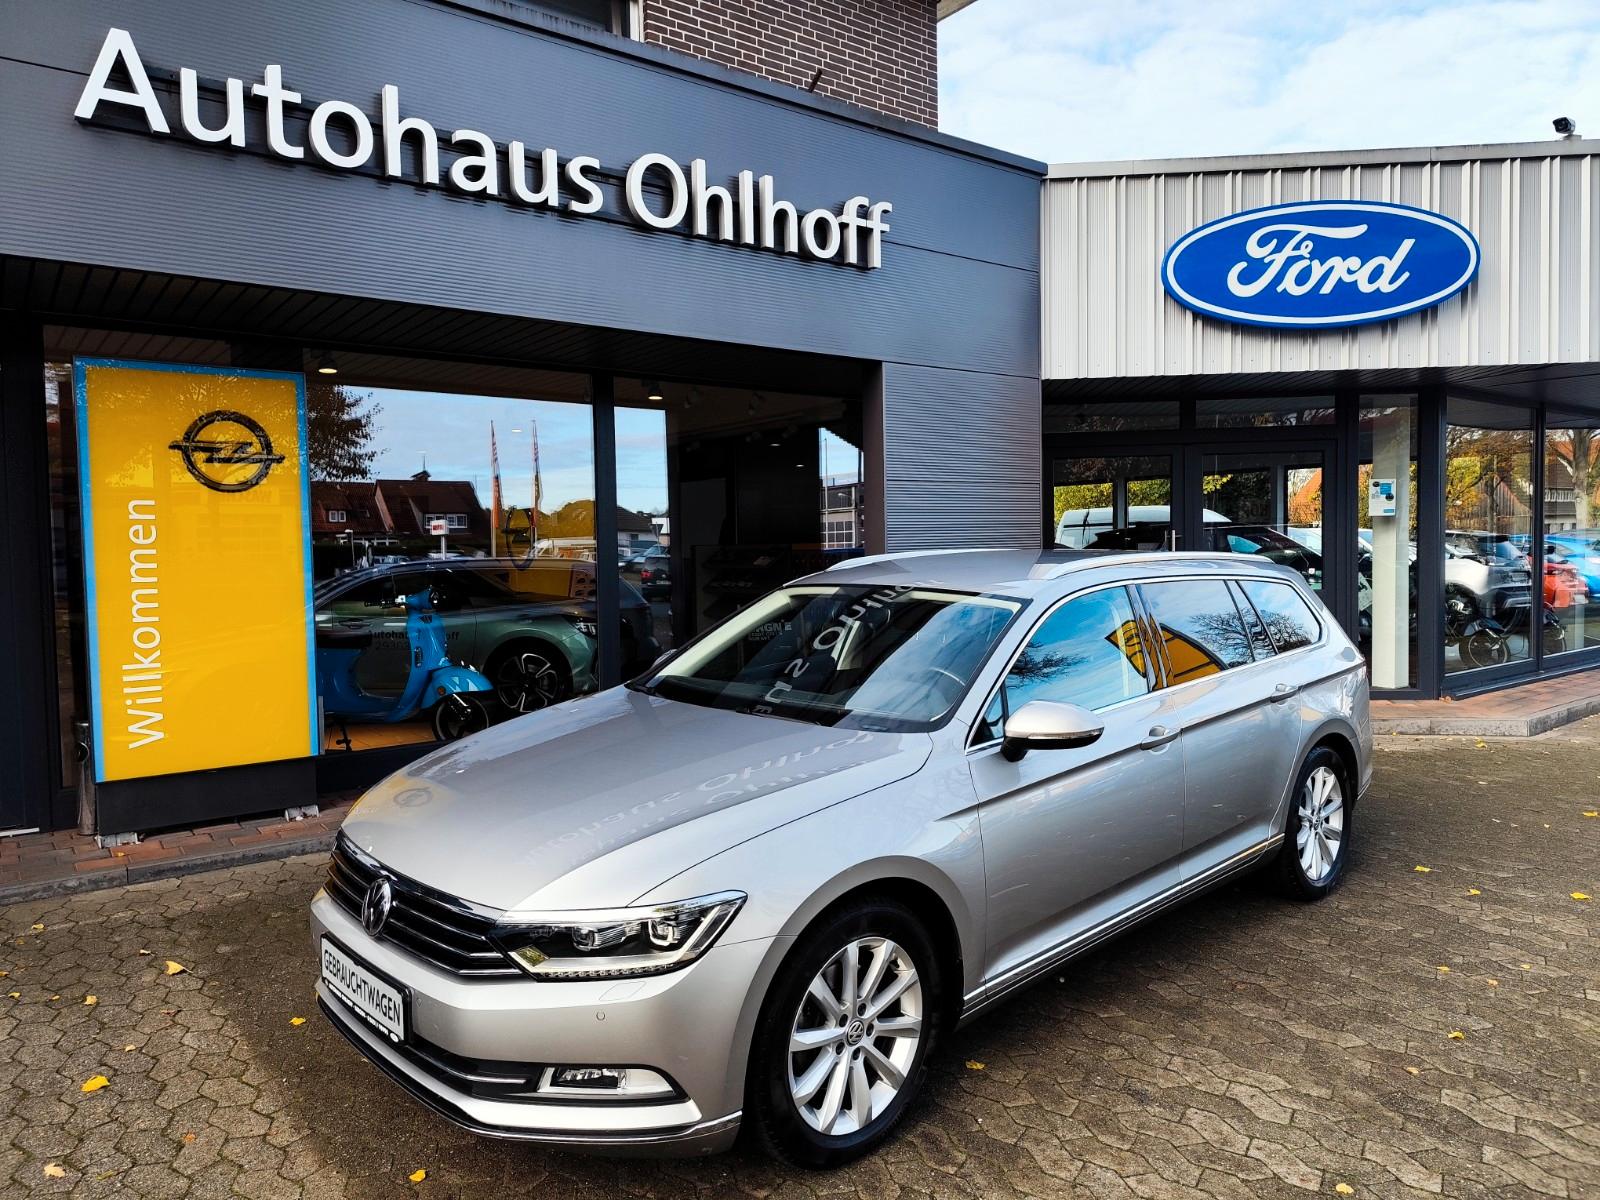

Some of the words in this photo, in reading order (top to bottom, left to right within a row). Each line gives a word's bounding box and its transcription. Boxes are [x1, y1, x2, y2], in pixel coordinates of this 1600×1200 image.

[74, 27, 604, 214] Autohaus
[625, 153, 893, 269] Ohlhoff
[1226, 223, 1416, 298] Ford
[121, 498, 165, 749] Willkommen
[323, 949, 401, 1026] GEBRAUCHTWAGEN
